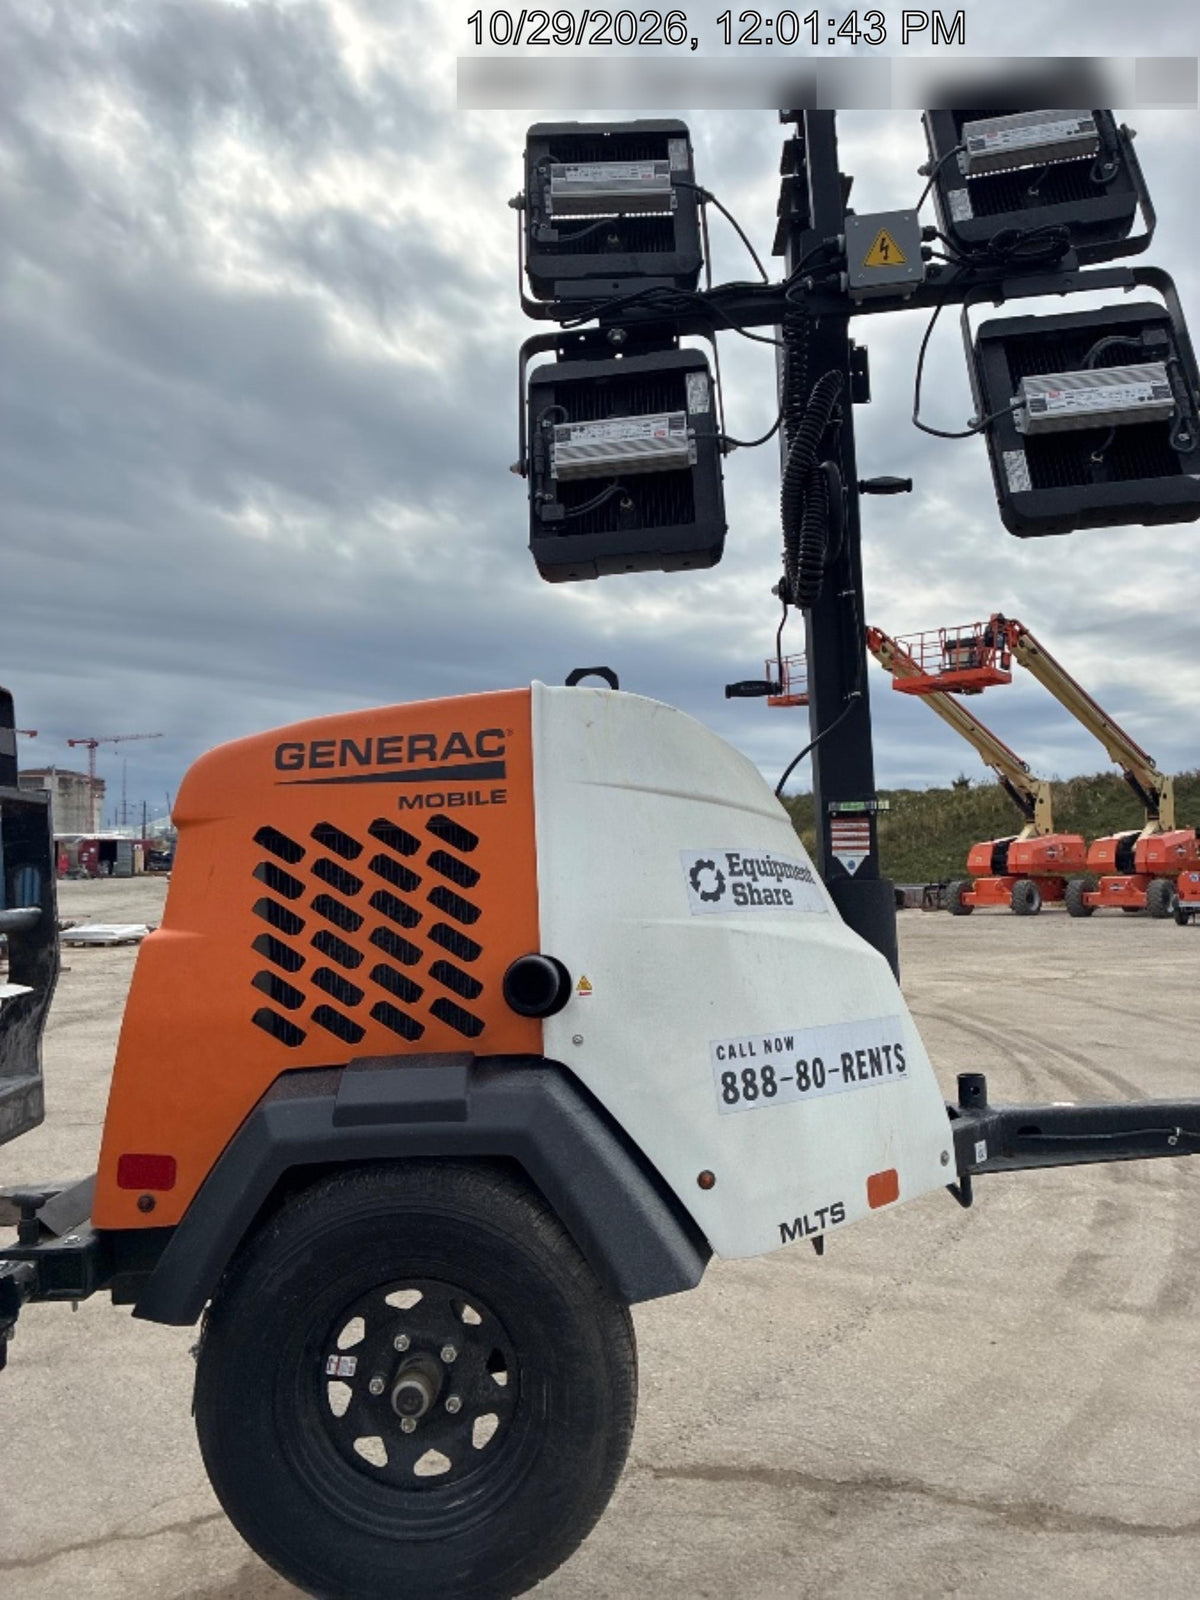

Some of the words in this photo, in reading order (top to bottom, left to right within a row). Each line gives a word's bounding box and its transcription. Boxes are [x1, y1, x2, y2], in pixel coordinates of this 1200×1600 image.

[275, 728, 506, 771] GENERAC
[398, 789, 507, 810] MOBILE
[732, 882, 793, 906] Share
[716, 1041, 757, 1060] CALL
[763, 1036, 794, 1054] NOW
[721, 1043, 906, 1105] 888-80-RENTS
[778, 1201, 845, 1244] MLTS
